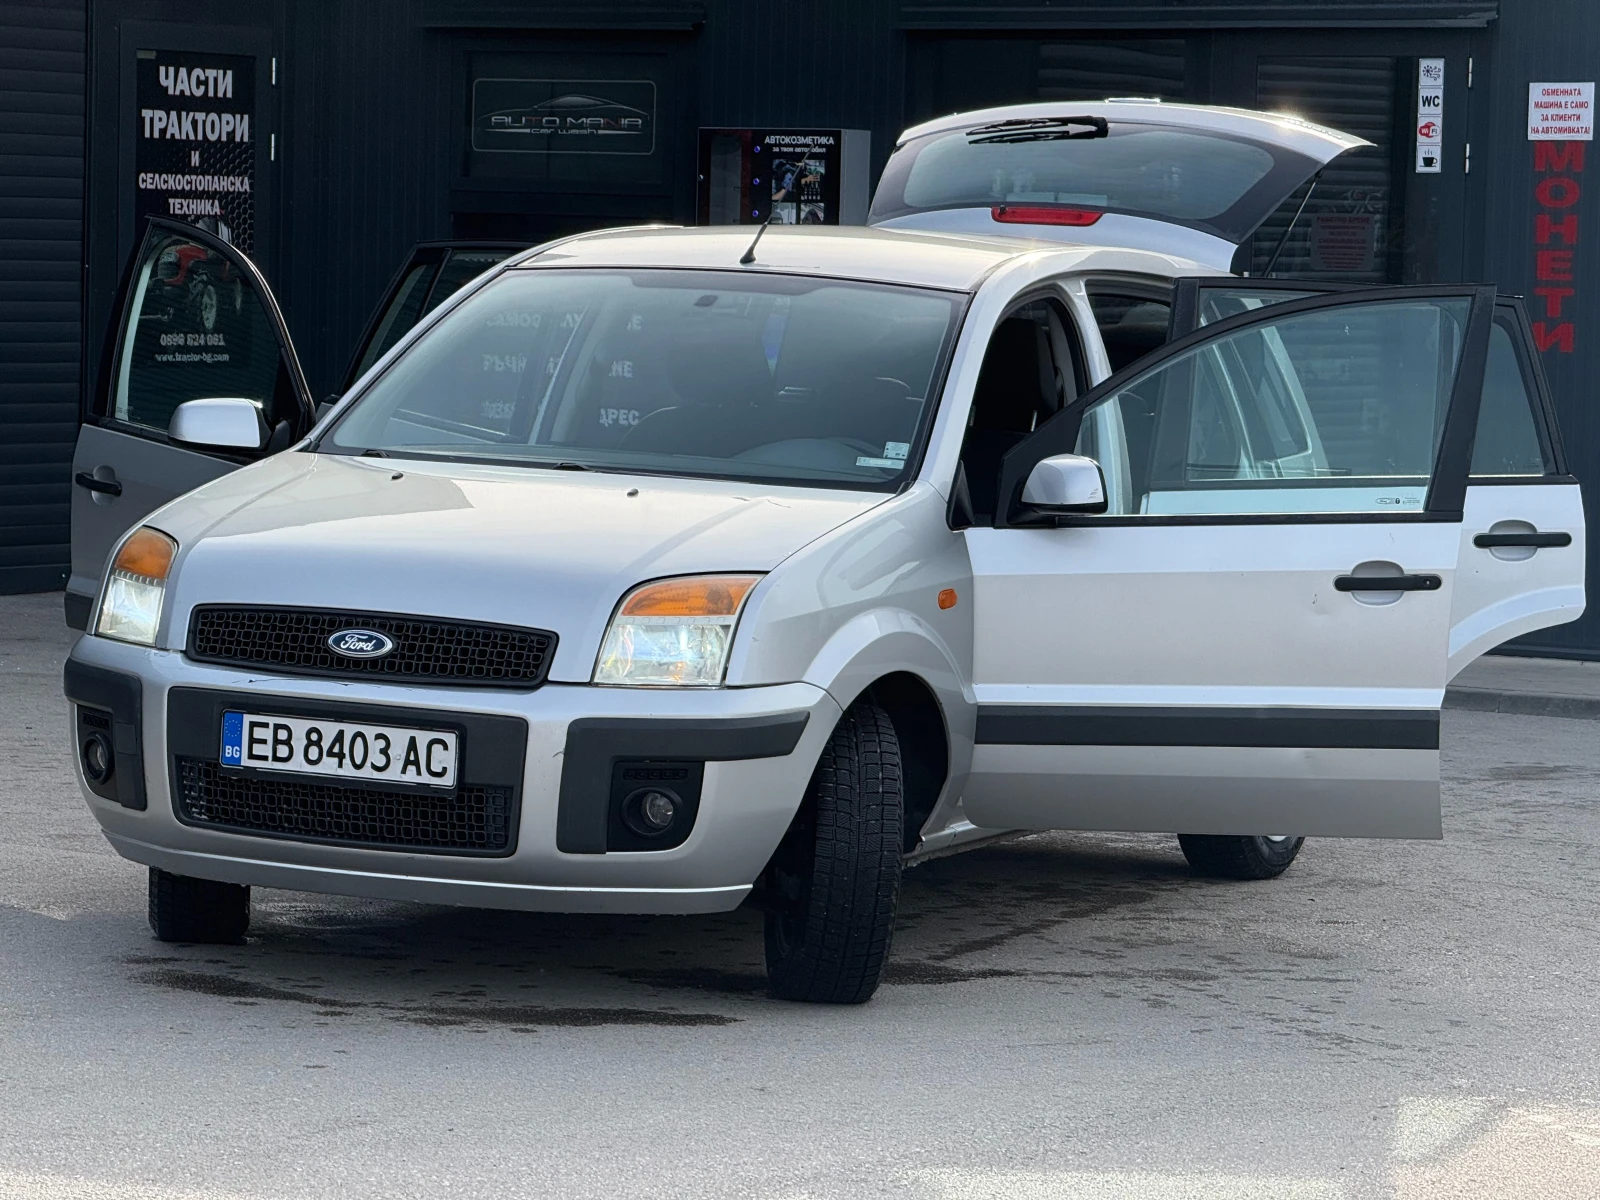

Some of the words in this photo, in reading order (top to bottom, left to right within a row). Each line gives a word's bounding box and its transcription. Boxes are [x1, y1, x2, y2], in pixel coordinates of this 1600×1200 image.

[159, 65, 233, 98] ЧАСТИ
[1541, 88, 1582, 96] ОБМЕННАТА
[1421, 95, 1440, 108] WC
[1534, 100, 1562, 109] МАШИНА
[1564, 101, 1568, 109] Е
[1570, 101, 1588, 109] САМО
[141, 108, 249, 143] ТРАКТОРИ
[491, 116, 559, 127] AUTO
[567, 117, 642, 128] MANIA
[1540, 114, 1549, 122] ЗА
[1551, 114, 1581, 122] КЛИЕНТИ
[1531, 126, 1539, 134] НА
[1541, 126, 1590, 134] АВТОМИВКАТА!
[764, 135, 835, 145] АВТОКОЗМЕТИКА
[190, 150, 200, 167] И
[138, 173, 250, 192] СЕЛСКОСТОПАНСКА
[168, 198, 220, 216] ТЕХНИКА
[1532, 142, 1585, 353] МОНЕТИ
[340, 634, 376, 651] Ford
[225, 745, 240, 758] BG
[247, 720, 294, 763] EB
[303, 727, 392, 772] 8403
[400, 735, 449, 778] AC
